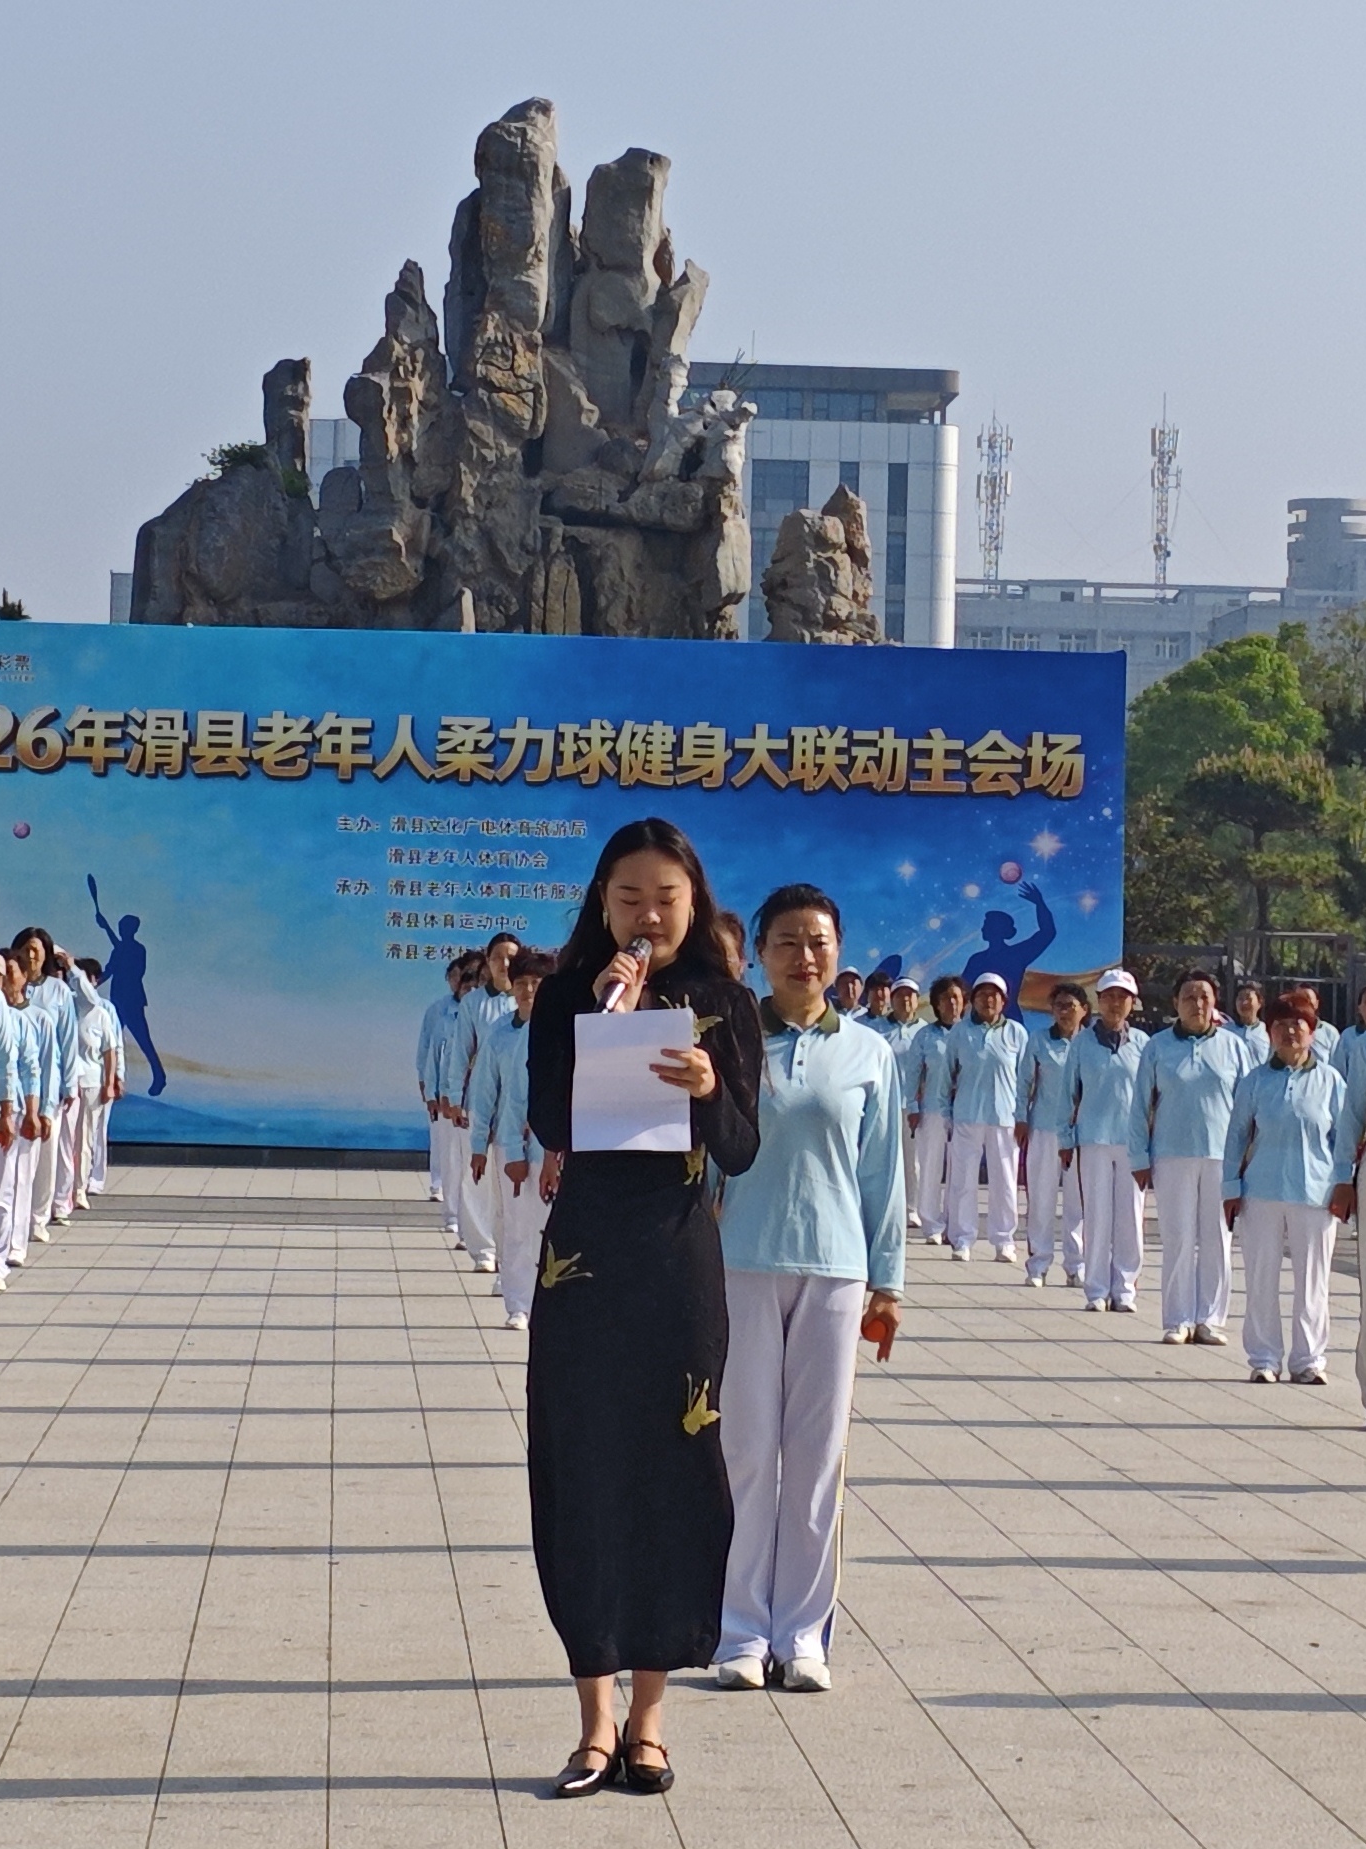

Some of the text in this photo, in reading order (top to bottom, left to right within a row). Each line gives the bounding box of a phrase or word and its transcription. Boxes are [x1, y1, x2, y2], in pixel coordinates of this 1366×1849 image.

[388, 848, 549, 869] 滑县老年人体育协会
[386, 911, 529, 932] 滑县体育运动中心
